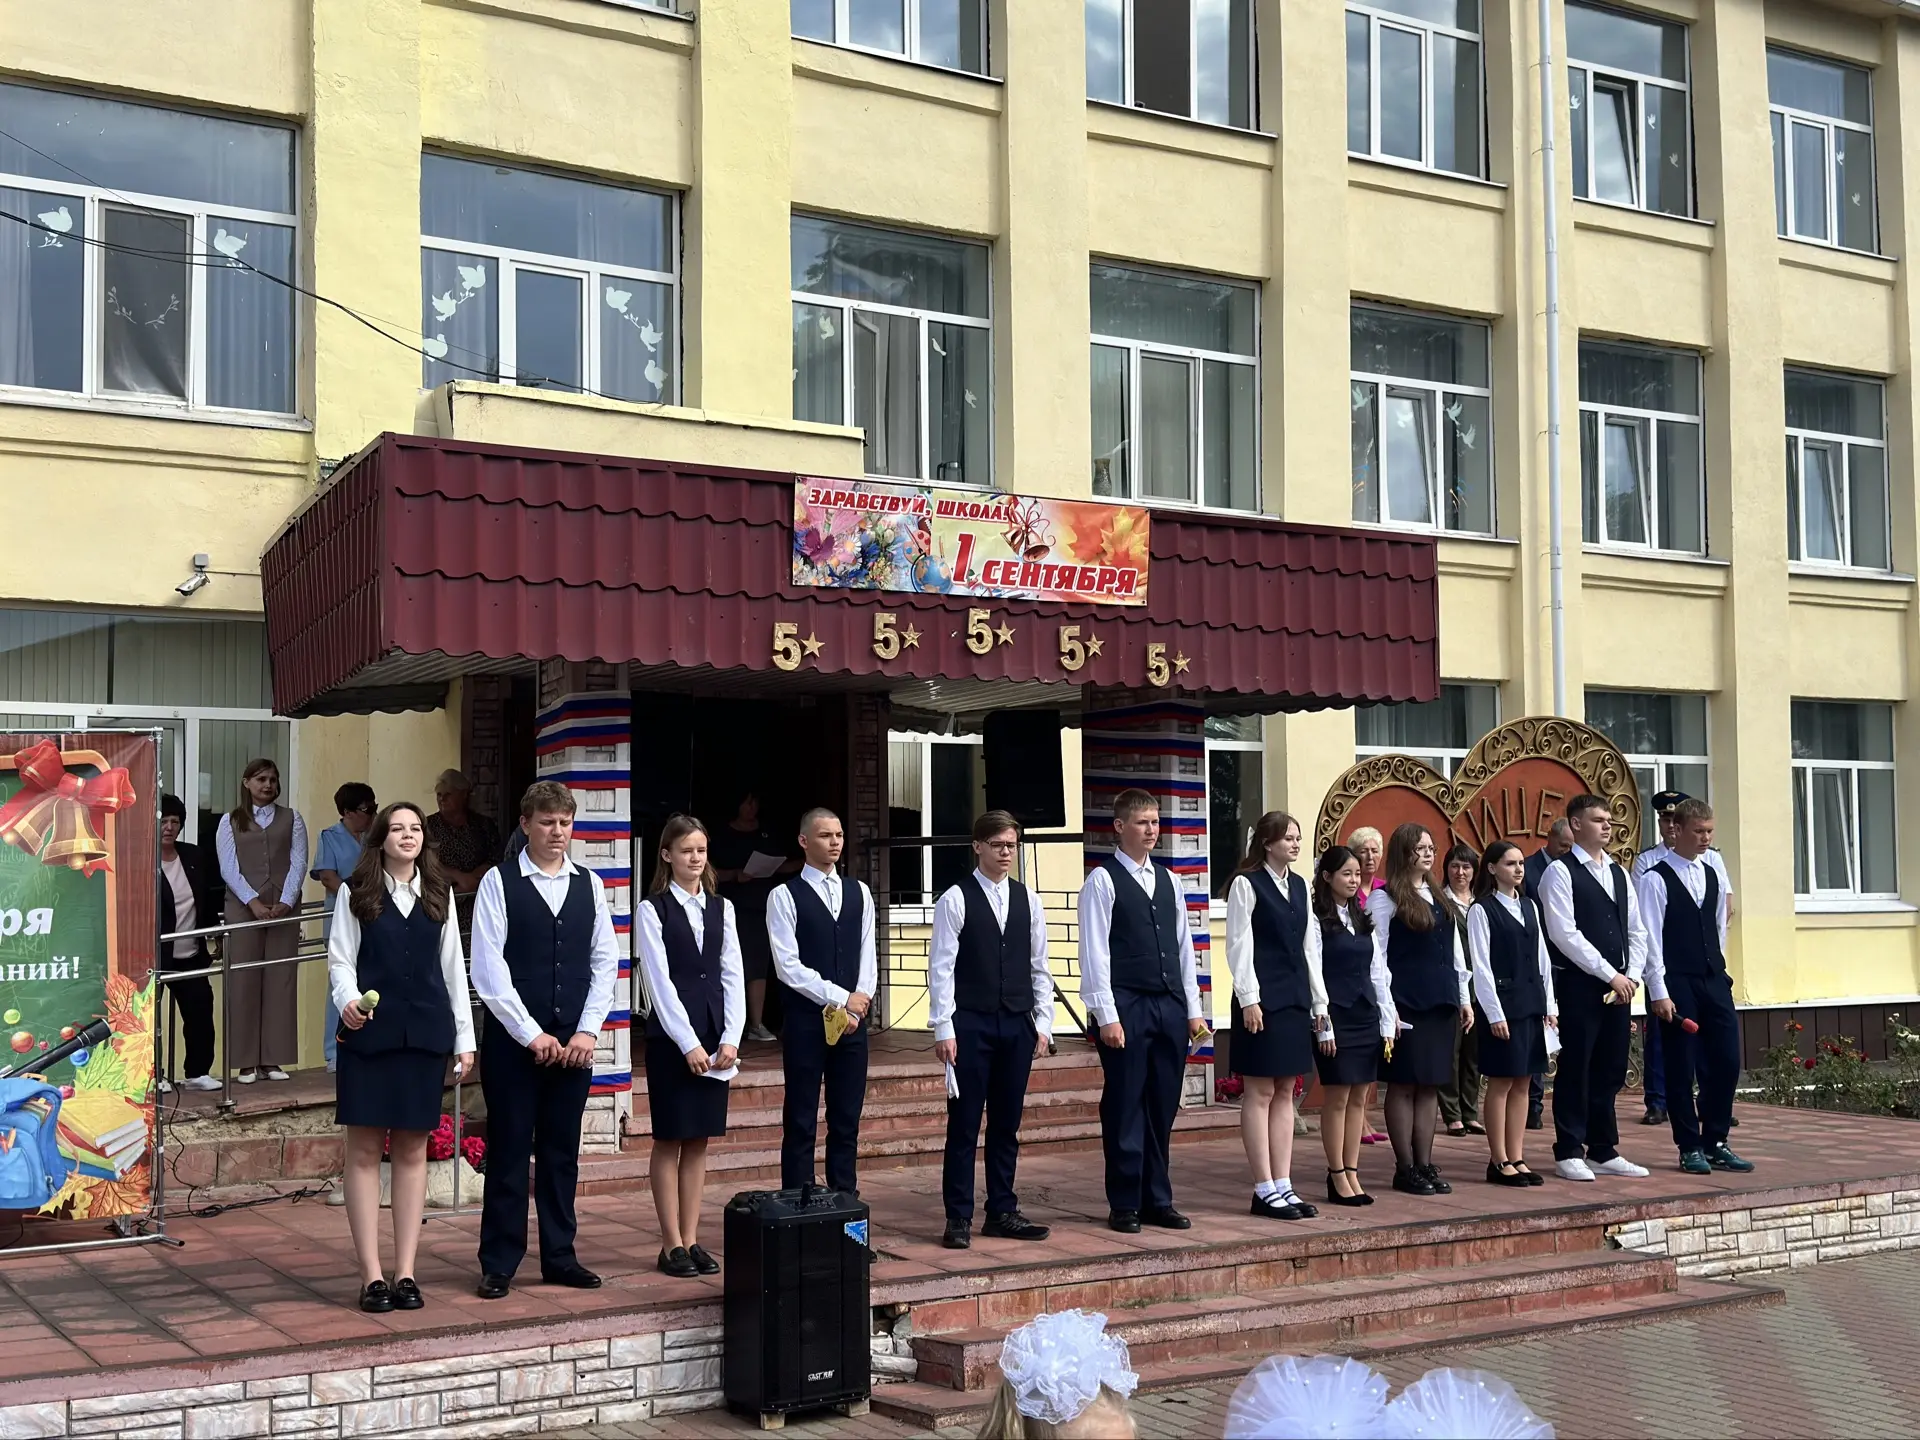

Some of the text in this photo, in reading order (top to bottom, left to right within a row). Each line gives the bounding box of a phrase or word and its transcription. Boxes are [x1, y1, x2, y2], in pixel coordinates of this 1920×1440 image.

[808, 488, 1009, 522] ЗДРАВСТВУЙ, ШКОЛА!
[952, 533, 1138, 595] 1 СЕНТЯБРЯ
[772, 608, 1170, 687] 5 5 5 5 5
[0, 956, 80, 981] ний!
